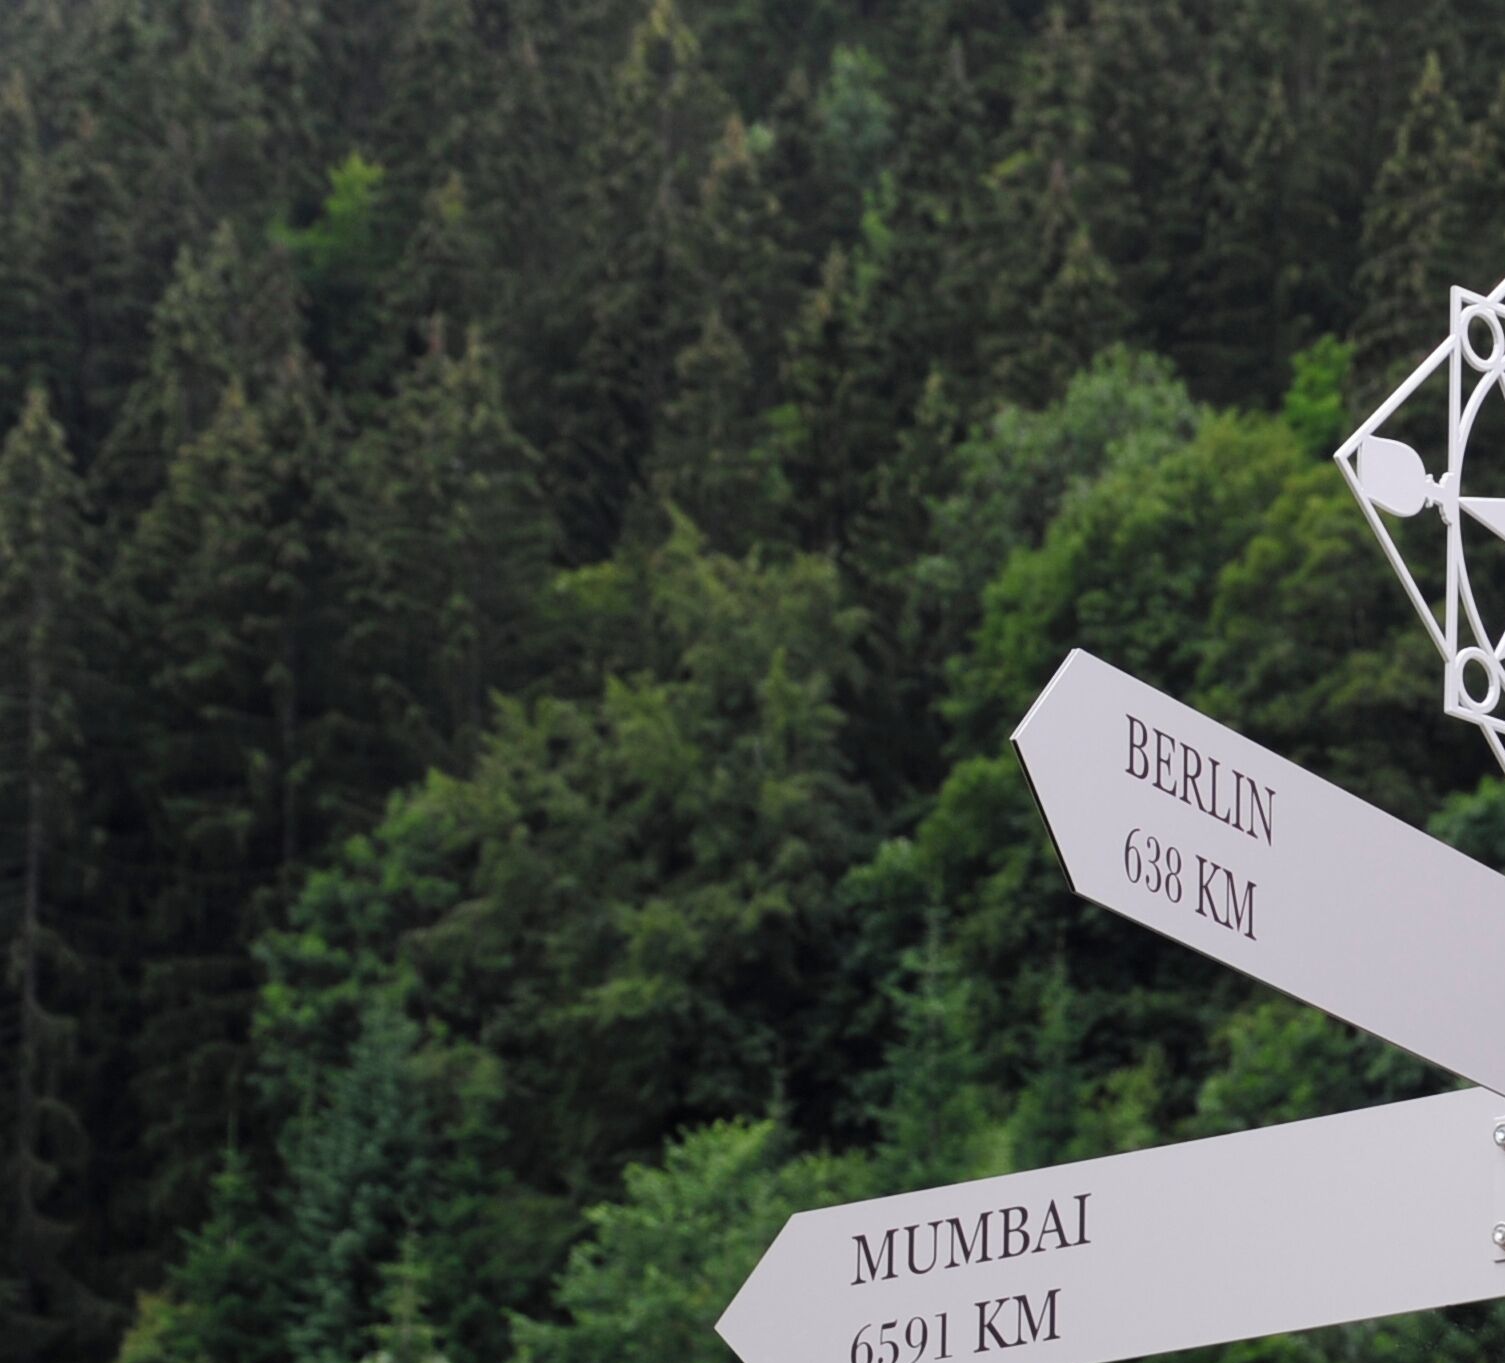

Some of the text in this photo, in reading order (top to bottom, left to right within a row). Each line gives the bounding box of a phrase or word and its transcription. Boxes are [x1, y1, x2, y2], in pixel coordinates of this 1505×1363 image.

[1126, 714, 1275, 846] BERLIN
[1125, 829, 1256, 940] 638 KM
[851, 1193, 1091, 1285] MUMBAI
[974, 1289, 1061, 1353] KM
